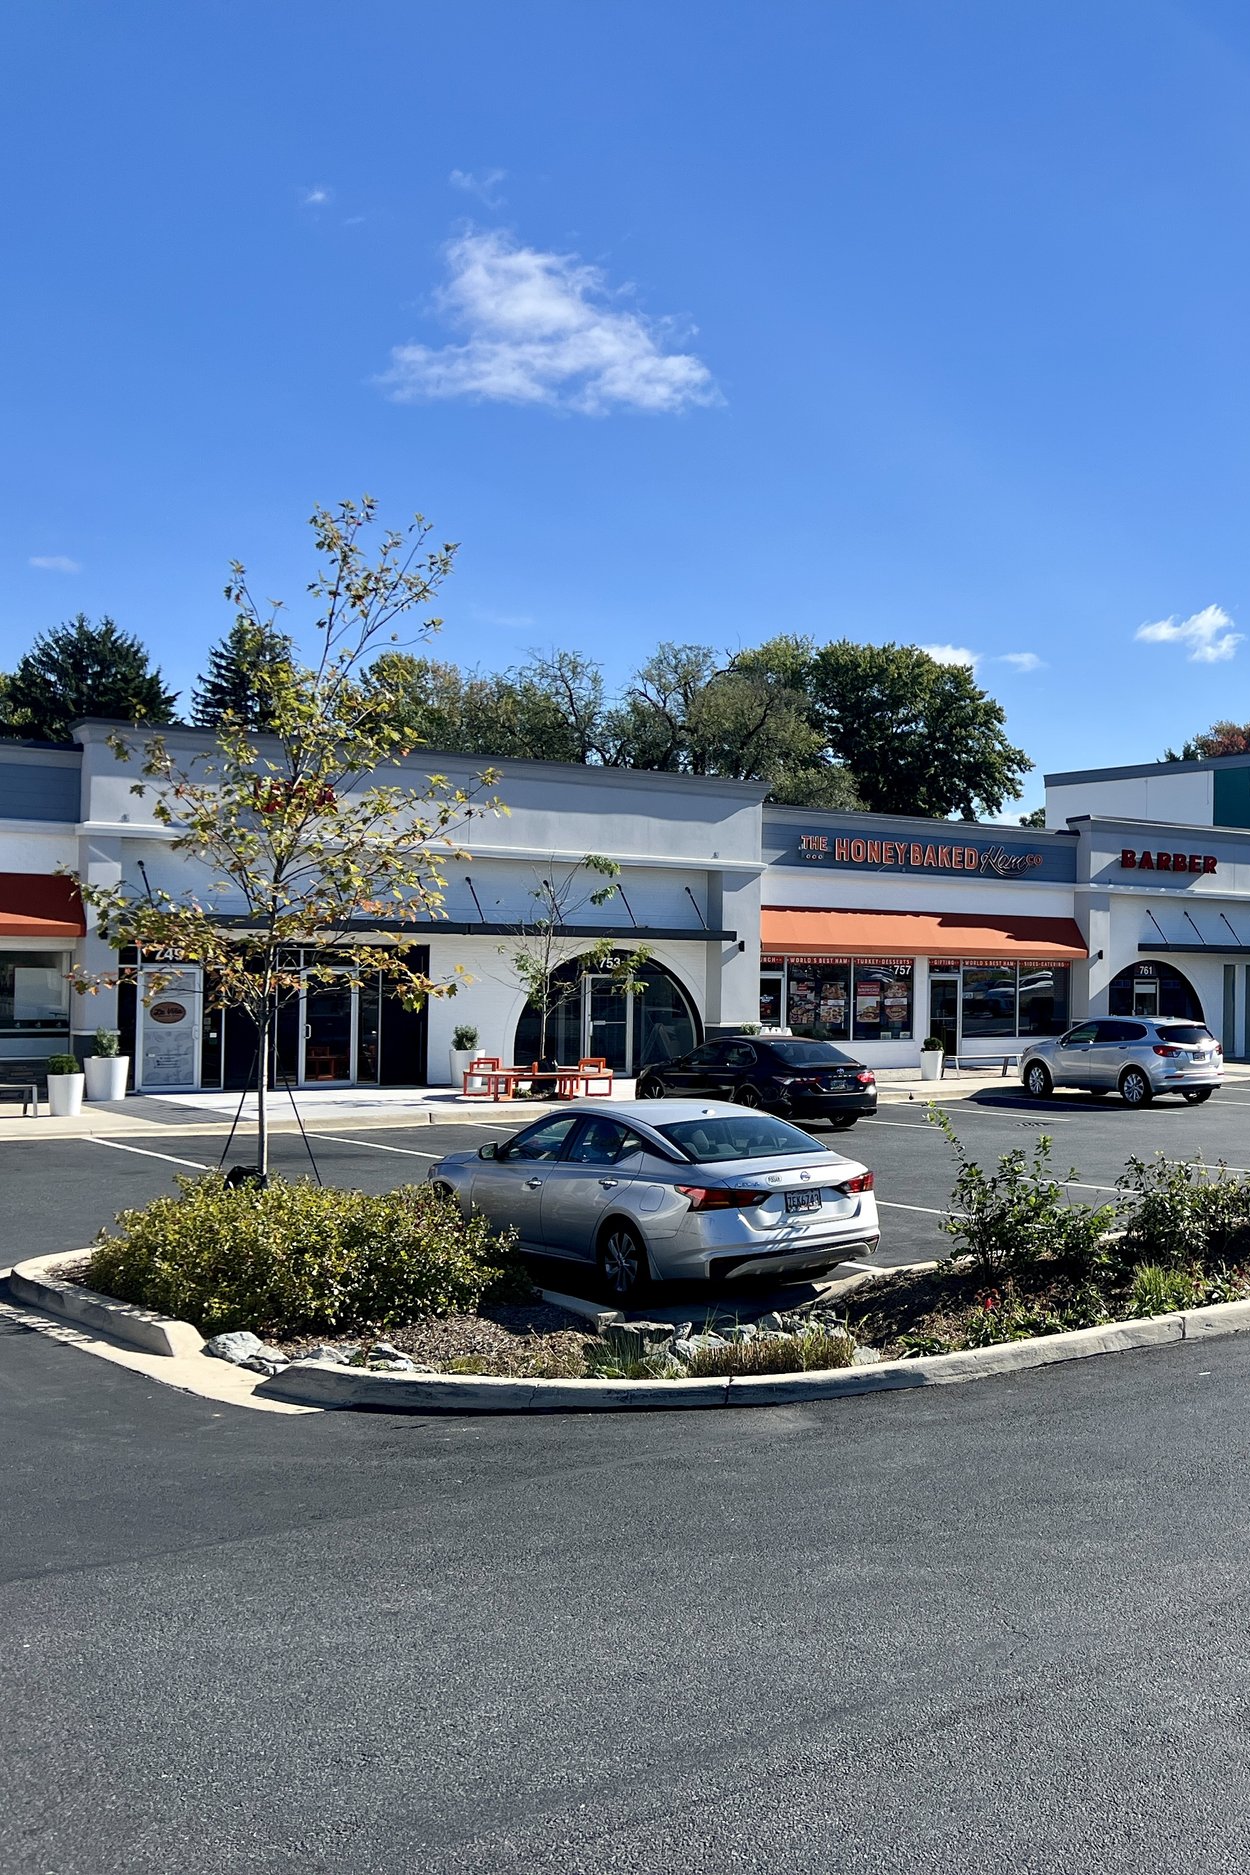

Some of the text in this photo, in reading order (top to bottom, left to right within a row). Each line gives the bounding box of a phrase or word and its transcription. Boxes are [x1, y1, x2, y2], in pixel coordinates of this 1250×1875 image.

[801, 834, 828, 851] THE
[1121, 849, 1217, 874] BARBER
[599, 957, 622, 969] 753
[893, 965, 912, 975] 757
[1139, 965, 1153, 975] 761
